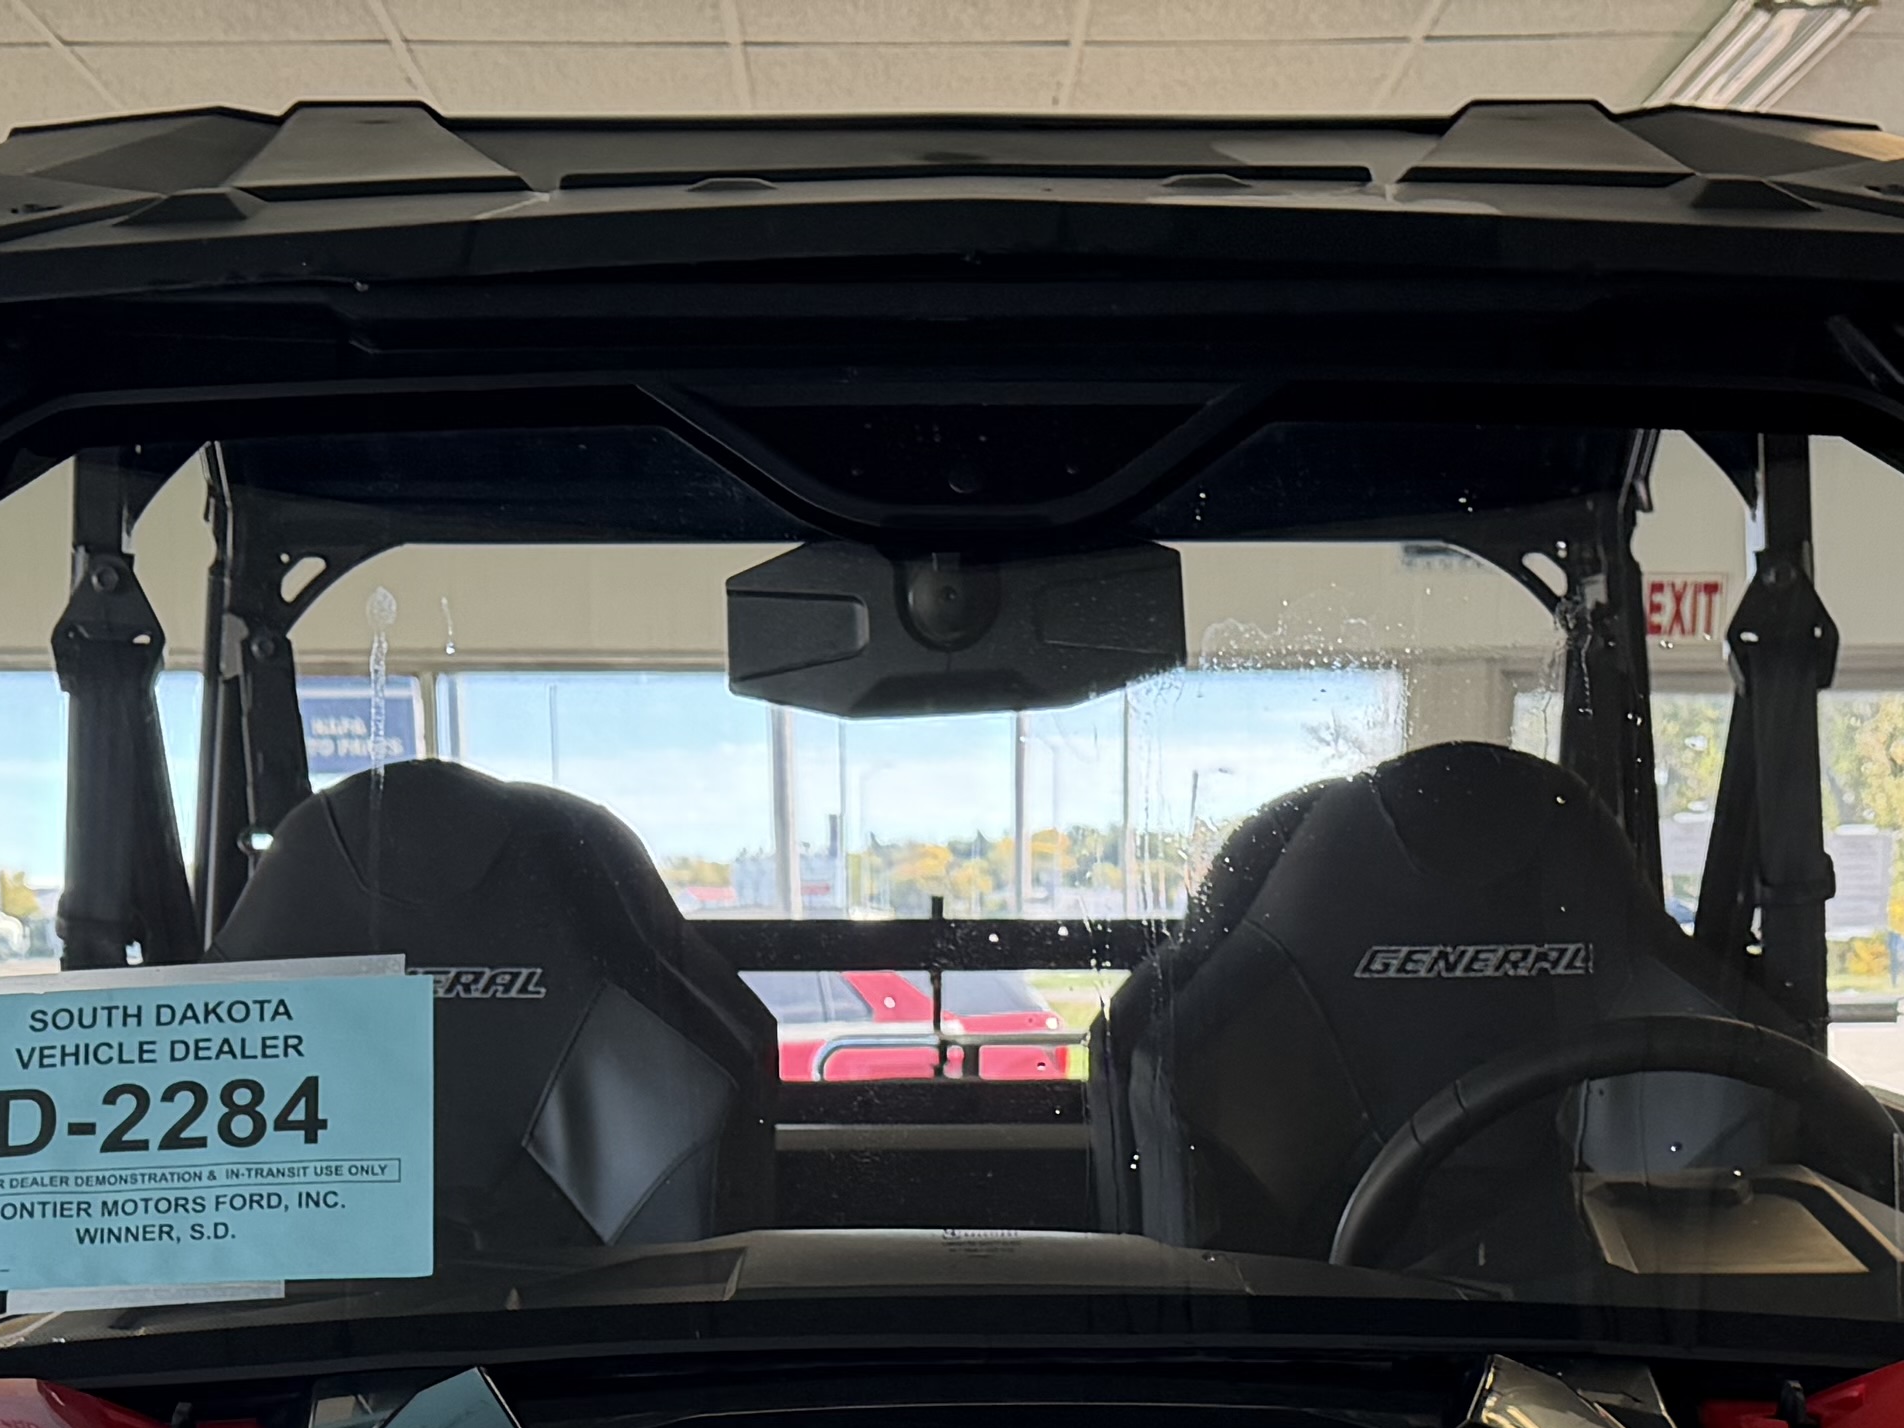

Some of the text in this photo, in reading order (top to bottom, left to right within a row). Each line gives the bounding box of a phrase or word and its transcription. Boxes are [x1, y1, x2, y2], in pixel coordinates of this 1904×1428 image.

[1647, 581, 1720, 636] EXIT
[1353, 942, 1593, 979] GENERAL
[408, 966, 547, 999] ERAL
[28, 999, 293, 1033] SOUTH DAKOTA
[15, 1034, 305, 1070] VEHICLE DEALER
[9, 1174, 70, 1190] DEALER
[74, 1170, 203, 1188] DEMONSTRATION
[206, 1169, 217, 1182] &
[225, 1165, 310, 1180] IN-TRANSIT
[313, 1164, 344, 1178] USE
[348, 1163, 388, 1177] ONLY
[100, 1196, 206, 1218] MOTORS
[214, 1191, 289, 1213] FORD,
[298, 1190, 346, 1210] INC.
[75, 1221, 237, 1246] WINNER, S.D.
